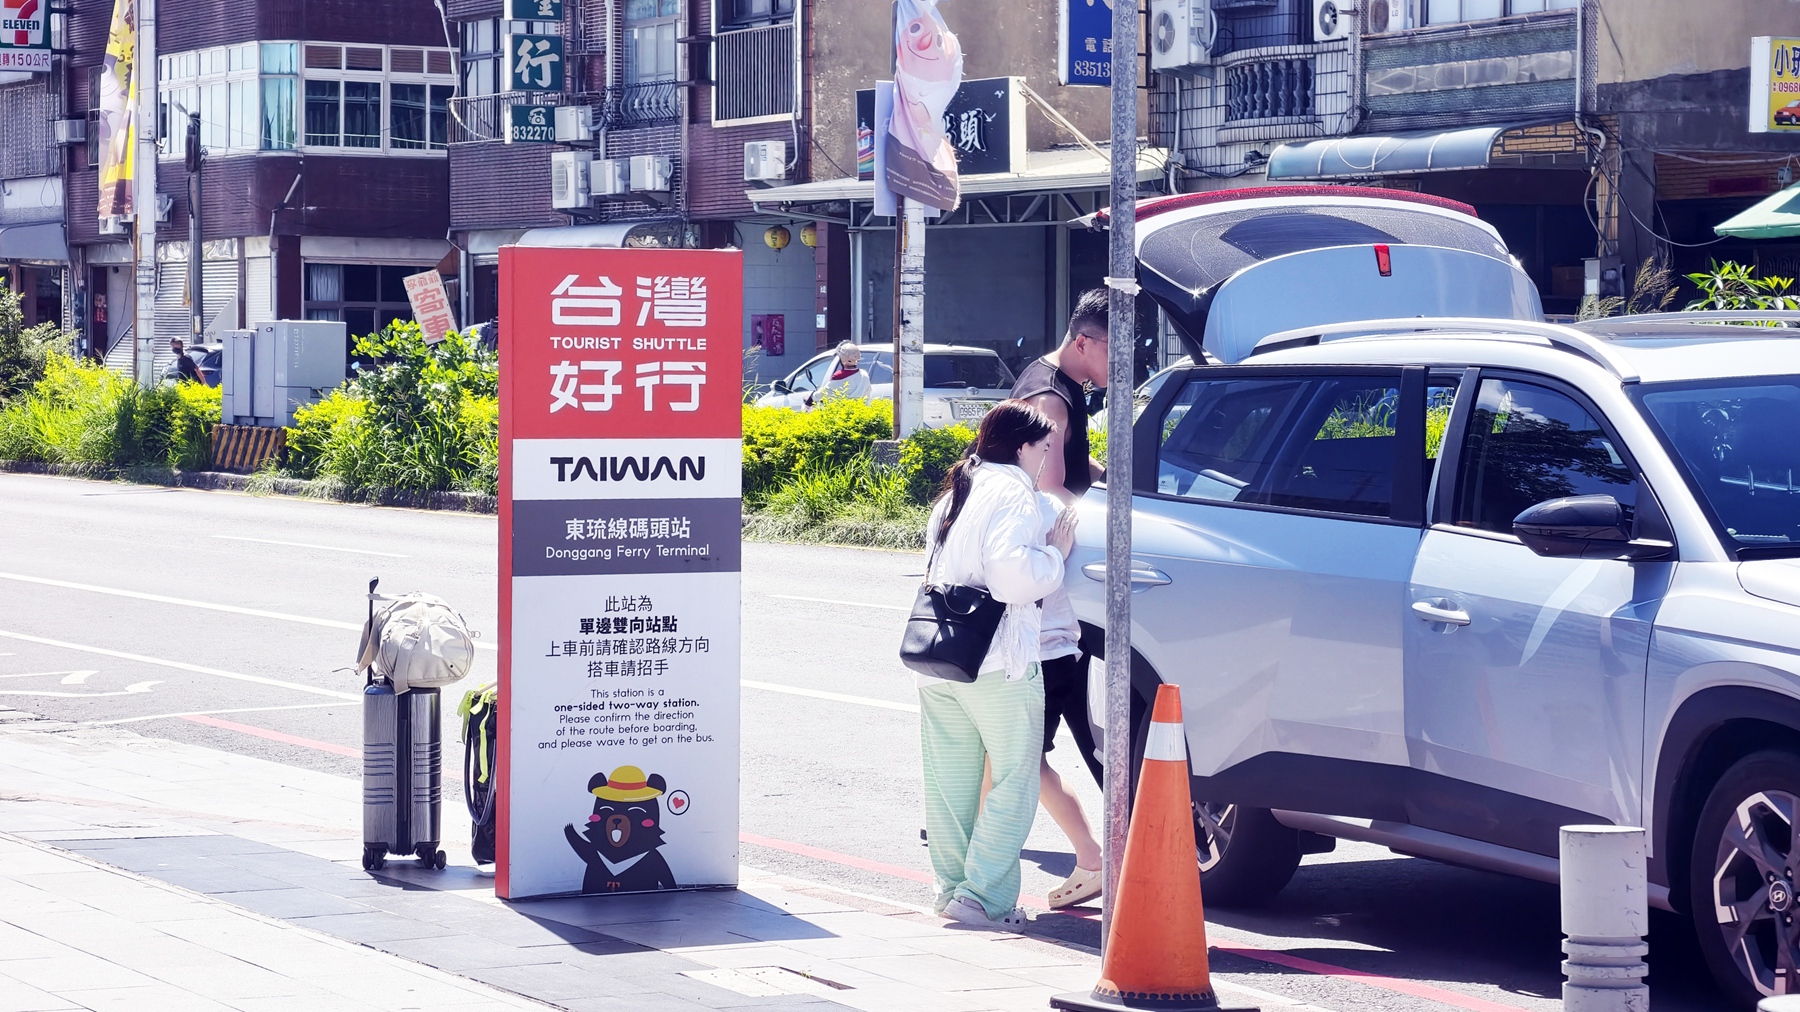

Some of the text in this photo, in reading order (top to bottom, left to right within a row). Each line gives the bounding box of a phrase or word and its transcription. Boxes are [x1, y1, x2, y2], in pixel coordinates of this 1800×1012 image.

[0, 53, 50, 67] 轉150公尺
[1074, 60, 1111, 78] 83513
[511, 125, 554, 141] 832270
[550, 274, 707, 327] 台灣
[550, 336, 707, 351] TOURIST SHUTTLE
[549, 360, 707, 414] 好行
[550, 455, 706, 482] TAIWAN
[565, 516, 691, 541] 東琉線碼頭站
[545, 543, 710, 561] Donggang Ferry Terminal
[604, 595, 653, 613] 此站為
[579, 615, 678, 635] 單邊雙向站點
[545, 636, 710, 657] 上車前請確認路線方向
[587, 658, 669, 678] 搭車請招手
[591, 688, 665, 699] This station is a
[554, 698, 700, 712] one-sided two-way station.
[559, 710, 694, 724] Please confirm the direction
[555, 727, 566, 737] of
[569, 726, 586, 736] the
[589, 725, 615, 735] route
[618, 723, 650, 733] before
[537, 733, 715, 750] and please wave to get on the bus.
